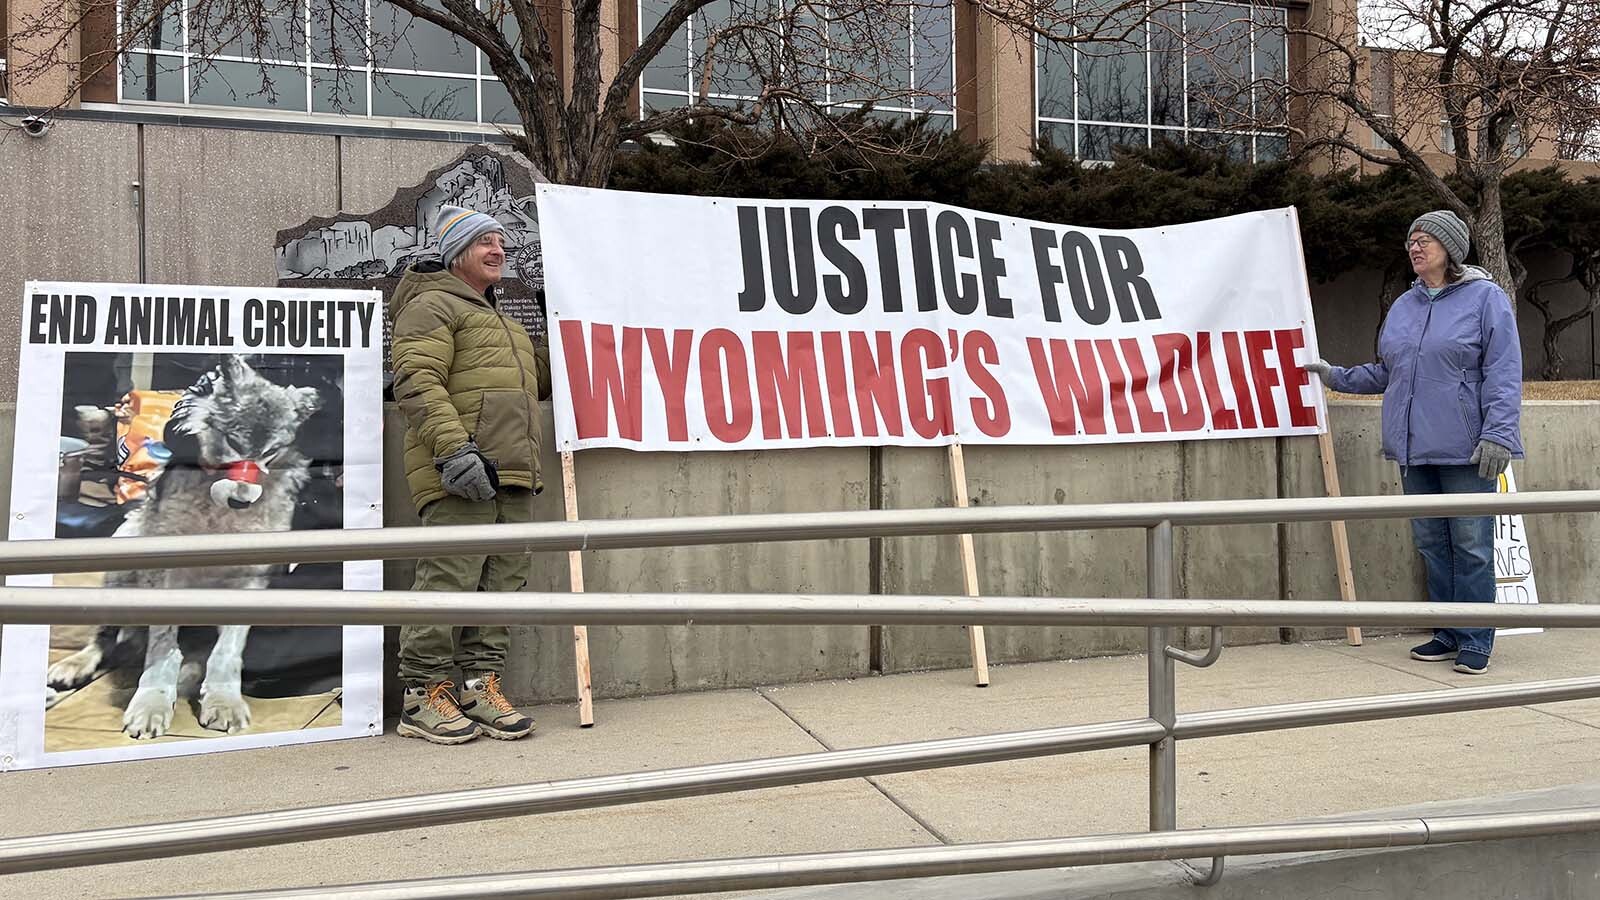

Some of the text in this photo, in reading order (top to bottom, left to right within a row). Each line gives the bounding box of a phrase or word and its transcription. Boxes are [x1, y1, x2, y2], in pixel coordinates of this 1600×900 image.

[29, 294, 97, 344] END
[104, 296, 234, 346] ANIMAL
[243, 298, 375, 348] CRUELTY
[737, 205, 1162, 325] JUSTICE FOR
[559, 320, 1318, 443] WYOMING'S WILDLIFE
